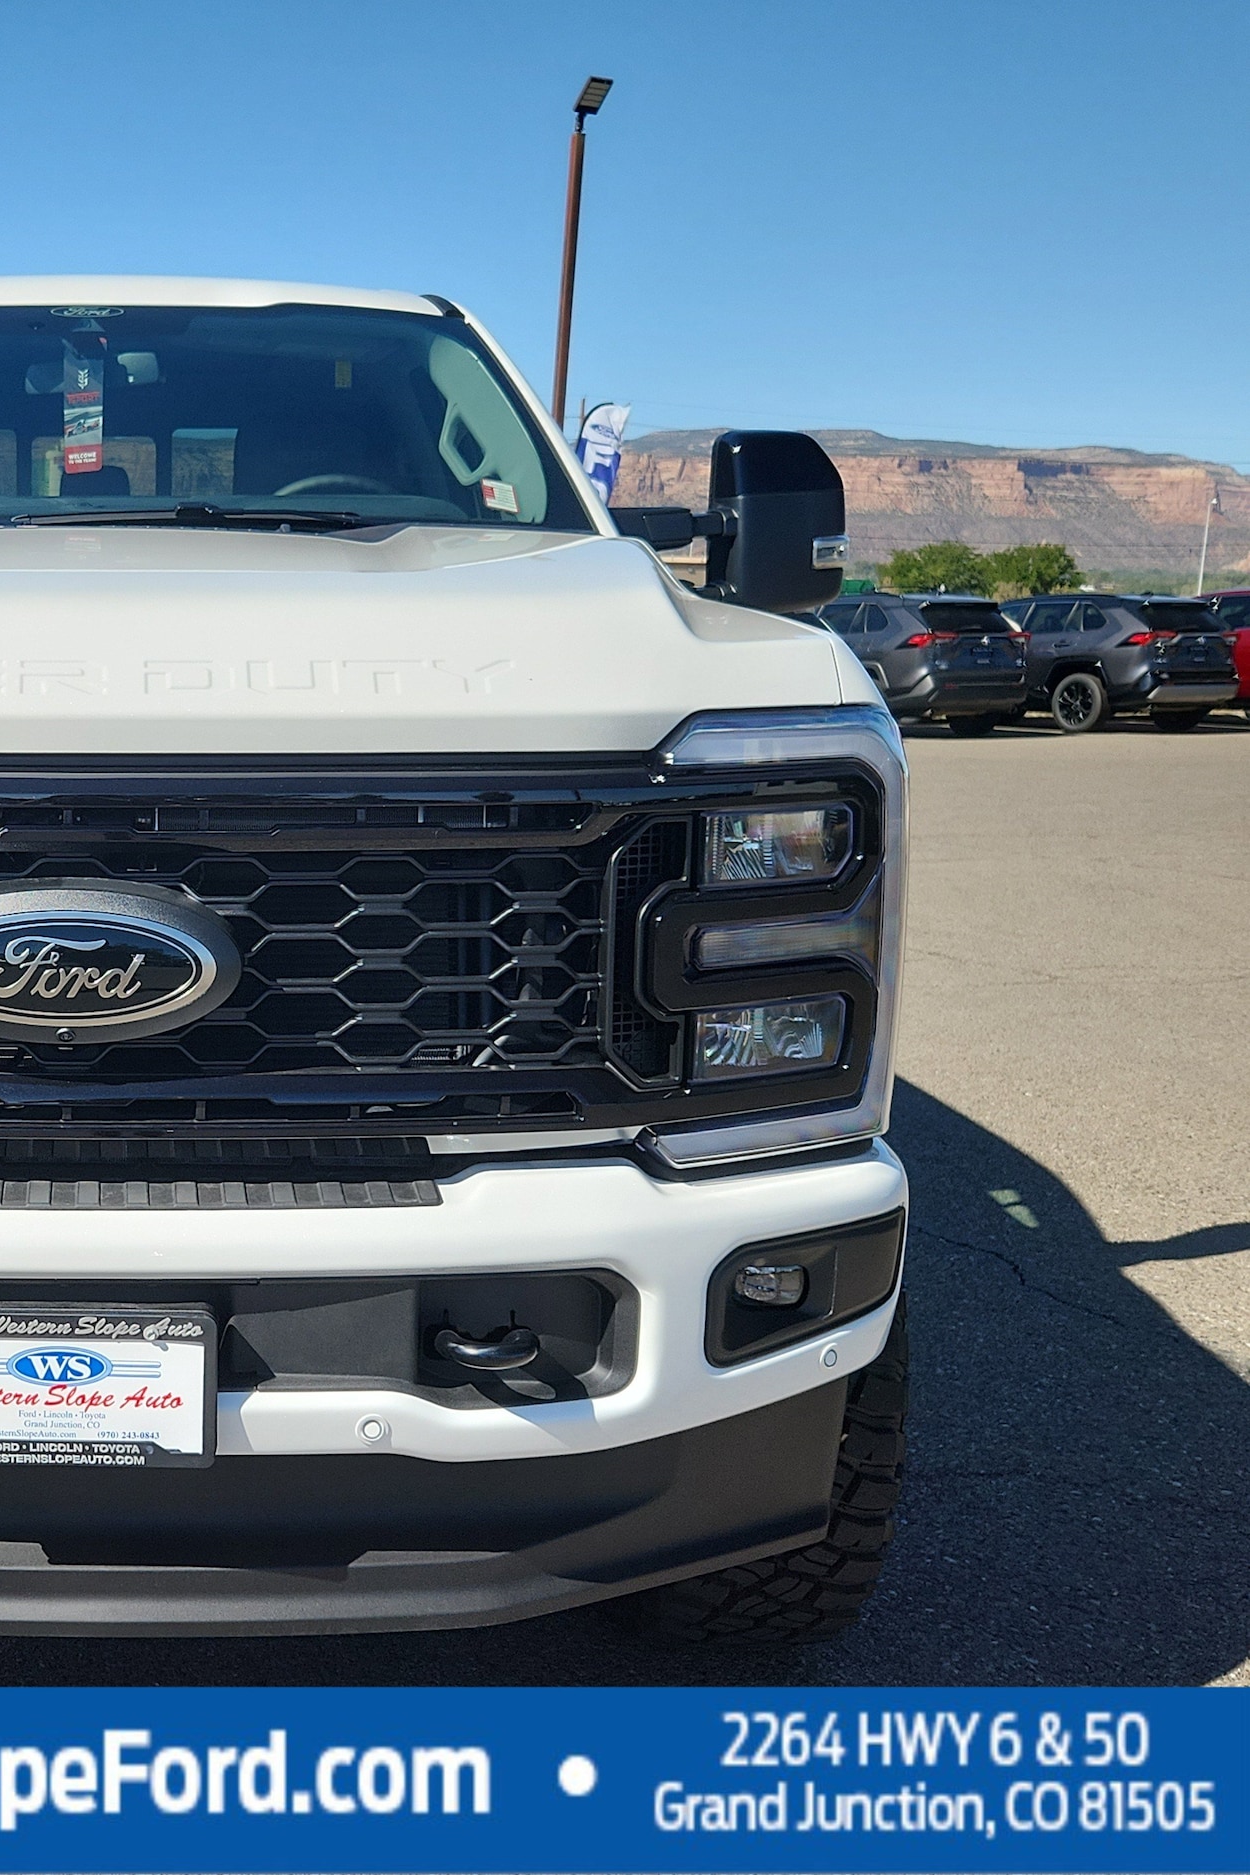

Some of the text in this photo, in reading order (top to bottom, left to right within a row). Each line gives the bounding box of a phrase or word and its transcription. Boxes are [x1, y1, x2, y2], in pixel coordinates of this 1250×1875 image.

[63, 307, 111, 316] Ford
[143, 657, 518, 695] DUTY
[74, 1315, 142, 1339] Slope
[147, 1317, 204, 1338] Auto
[26, 1354, 92, 1381] WS
[44, 1383, 116, 1413] Slope
[120, 1386, 184, 1410] Auto
[18, 1409, 106, 1421] Ford Lincoln Toyota
[23, 1420, 101, 1430] Grand Junction, CO
[97, 1431, 120, 1440] (970)
[121, 1431, 161, 1440] 243-0843
[29, 1442, 84, 1453] LINCOLN
[91, 1443, 141, 1454] TOYOTA
